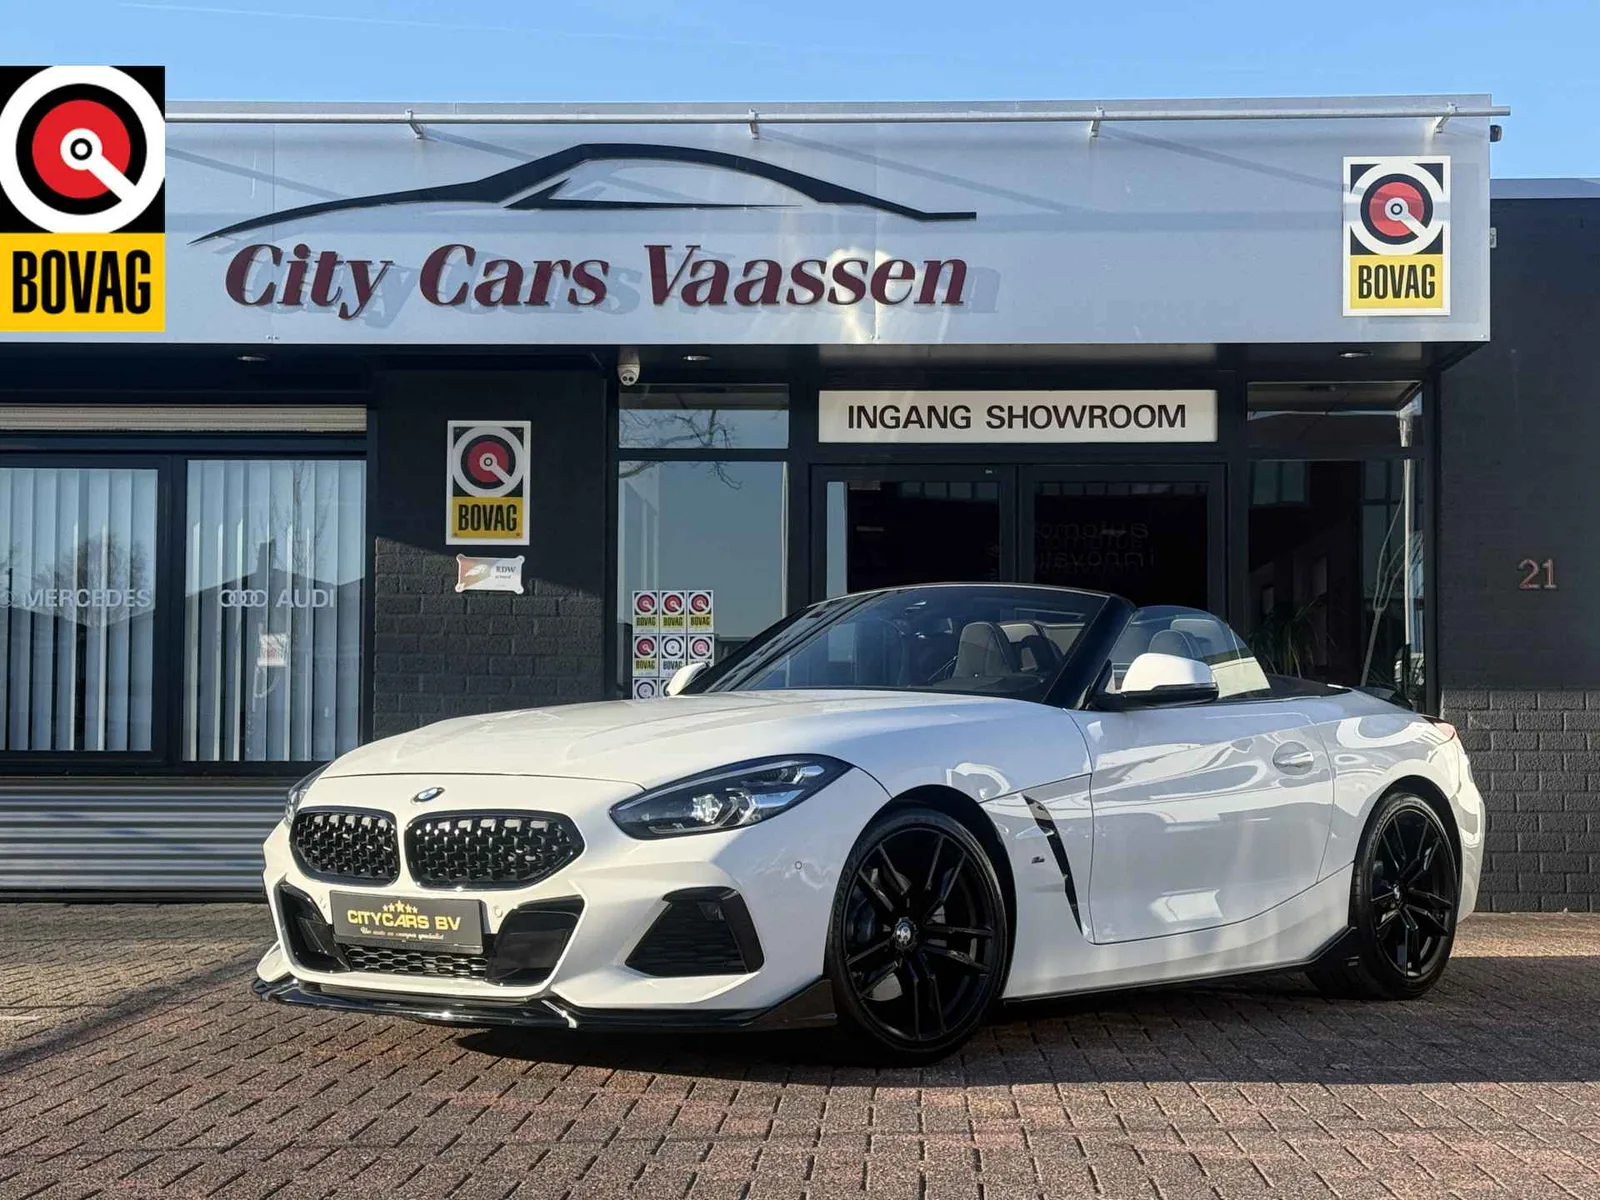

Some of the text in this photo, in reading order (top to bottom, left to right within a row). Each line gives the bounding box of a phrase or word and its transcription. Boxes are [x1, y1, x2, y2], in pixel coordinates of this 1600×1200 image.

[225, 243, 968, 321] City Cars Vaassen
[1358, 264, 1436, 299] BOVAG
[847, 404, 1187, 430] INGANG SHOWROOM
[458, 504, 517, 531] BOVAG
[1516, 558, 1558, 590] 21
[23, 588, 151, 608] MERCEDES
[275, 588, 335, 608] AUDI
[663, 617, 683, 627] BOVAG
[690, 616, 710, 626] BOVAG
[636, 660, 655, 670] BOVAG
[347, 909, 461, 931] CITYCARS BV
